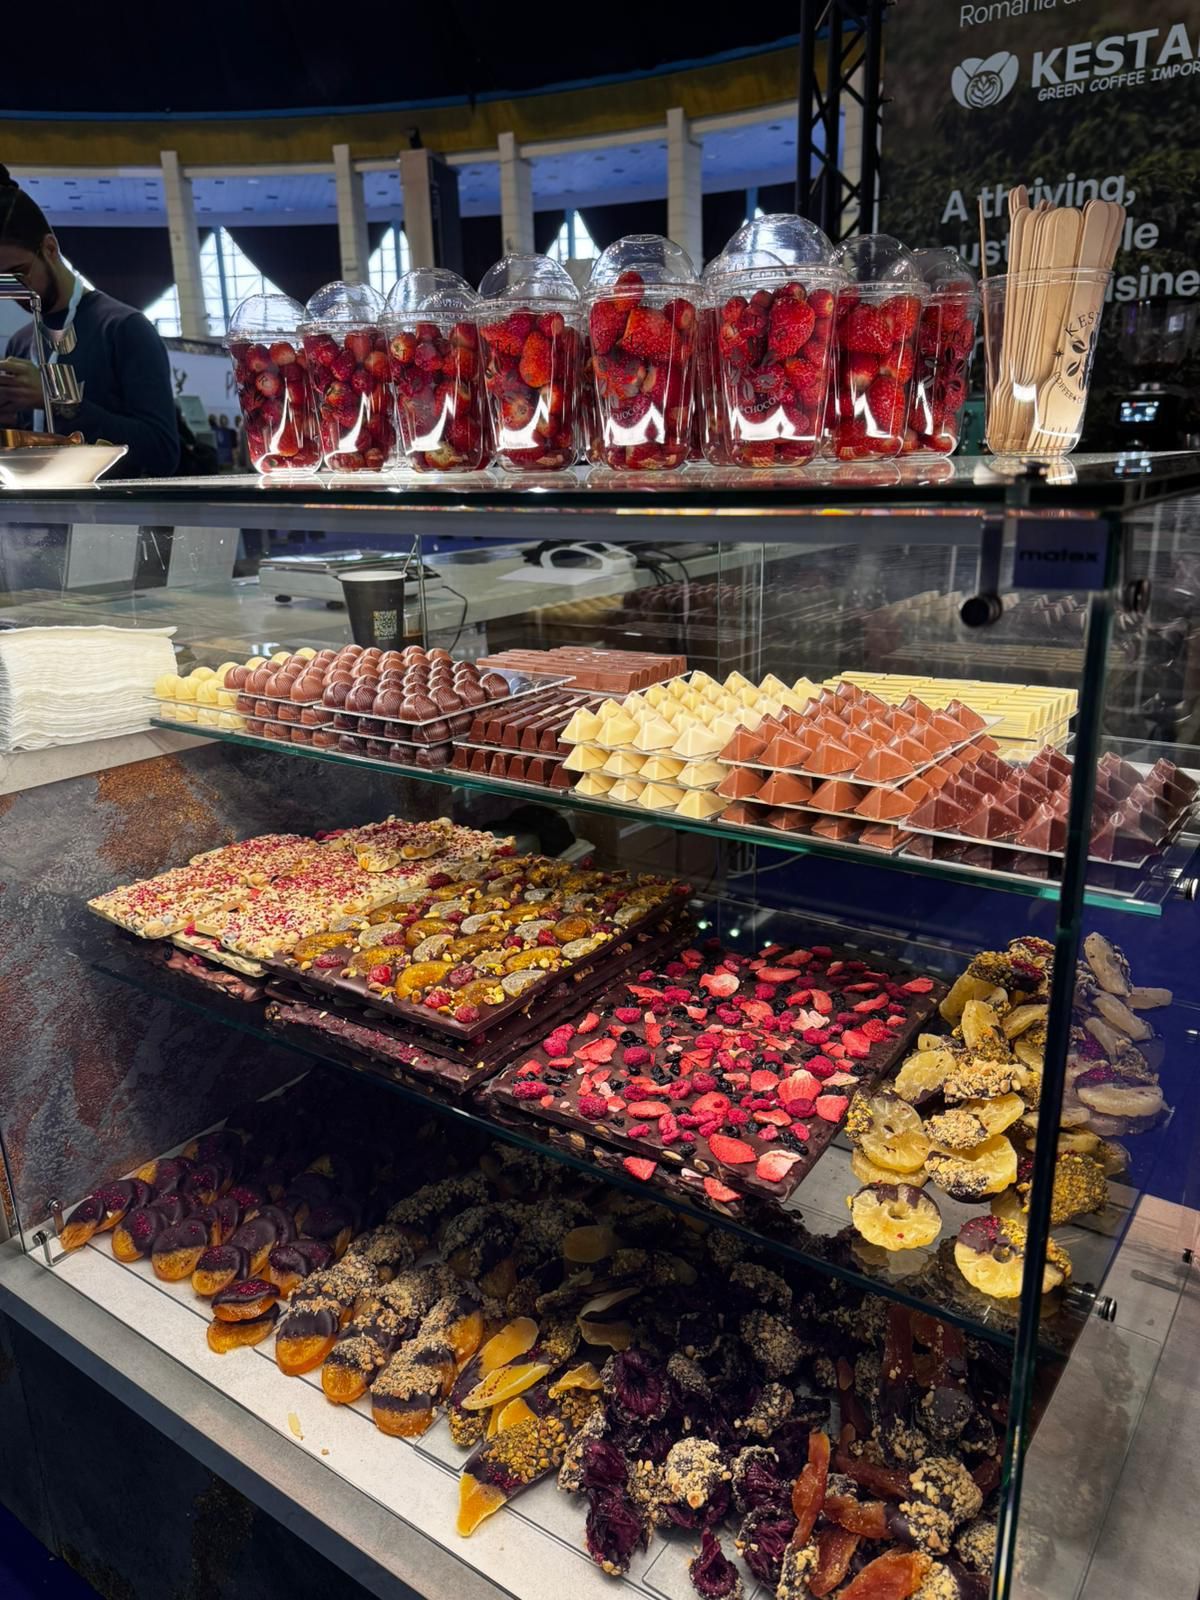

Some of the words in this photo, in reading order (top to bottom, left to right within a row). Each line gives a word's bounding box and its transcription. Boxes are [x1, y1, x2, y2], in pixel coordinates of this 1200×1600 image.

[1031, 23, 1200, 88] KESTA
[1037, 82, 1085, 101] GREEN
[1089, 69, 1146, 93] COFFEE
[940, 189, 969, 225] A
